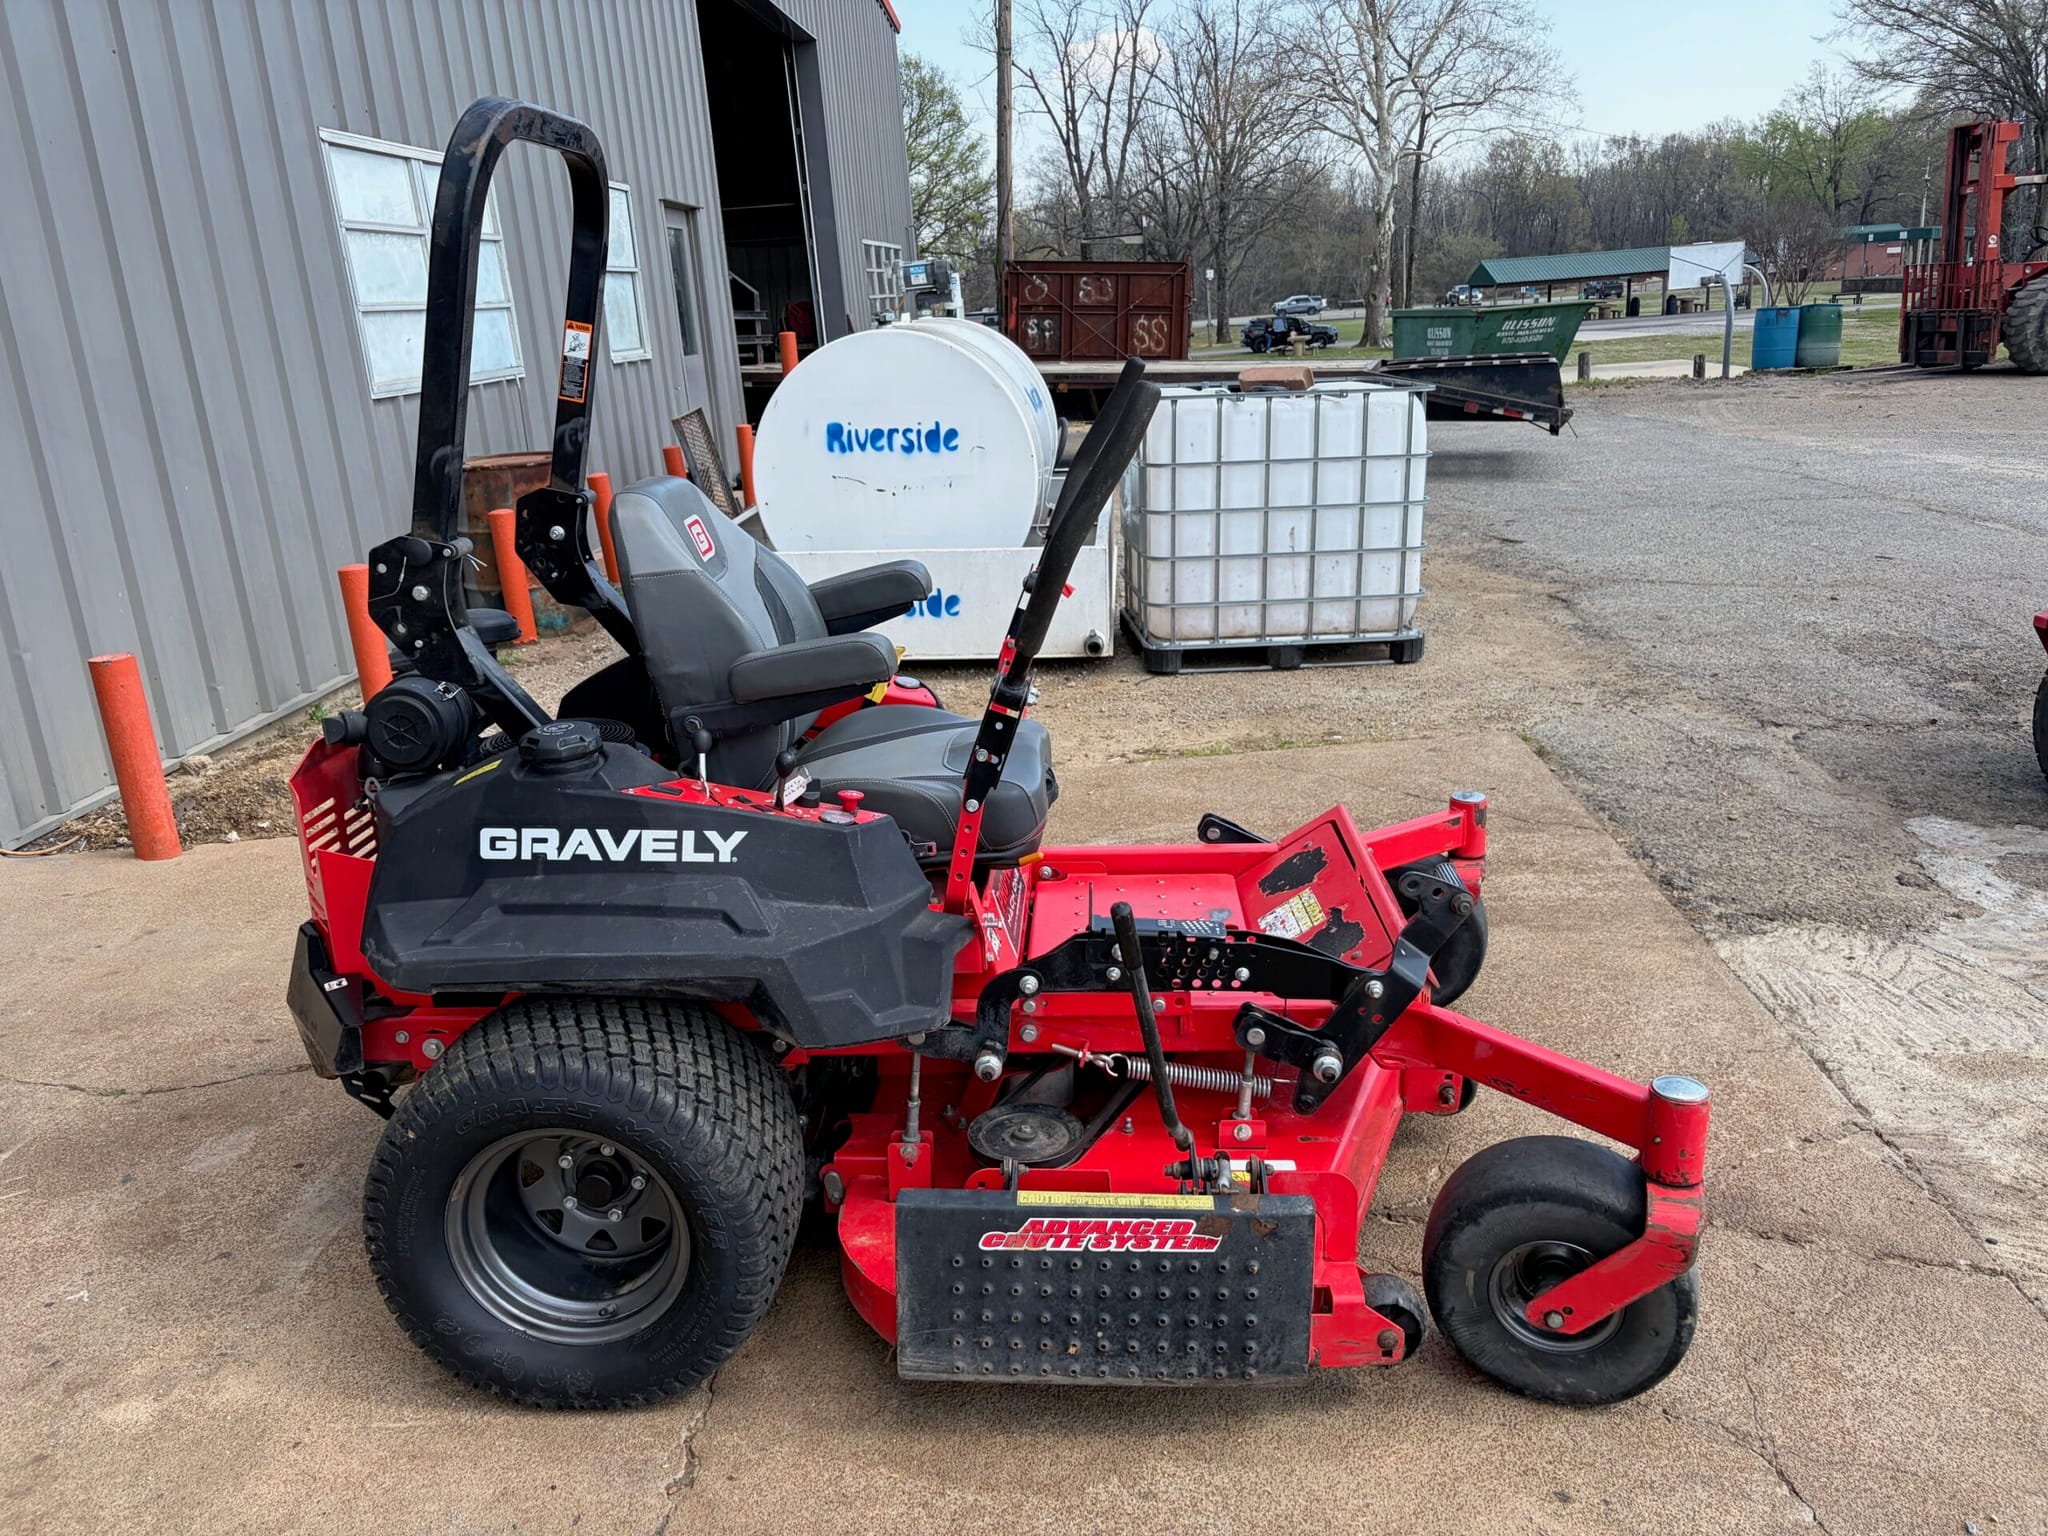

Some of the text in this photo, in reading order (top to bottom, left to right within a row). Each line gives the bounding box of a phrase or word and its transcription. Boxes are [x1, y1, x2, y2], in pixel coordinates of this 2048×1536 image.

[827, 420, 960, 455] Riverside
[479, 827, 749, 862] GRAVELY
[1019, 1191, 1075, 1204] CAUTION:
[1076, 1196, 1116, 1206] OPERATE
[1118, 1197, 1141, 1206] WITH
[1143, 1197, 1177, 1208] SHIELD
[1020, 1219, 1195, 1235] ADVANCED
[981, 1232, 1222, 1250] CHUTE SYSTEM
